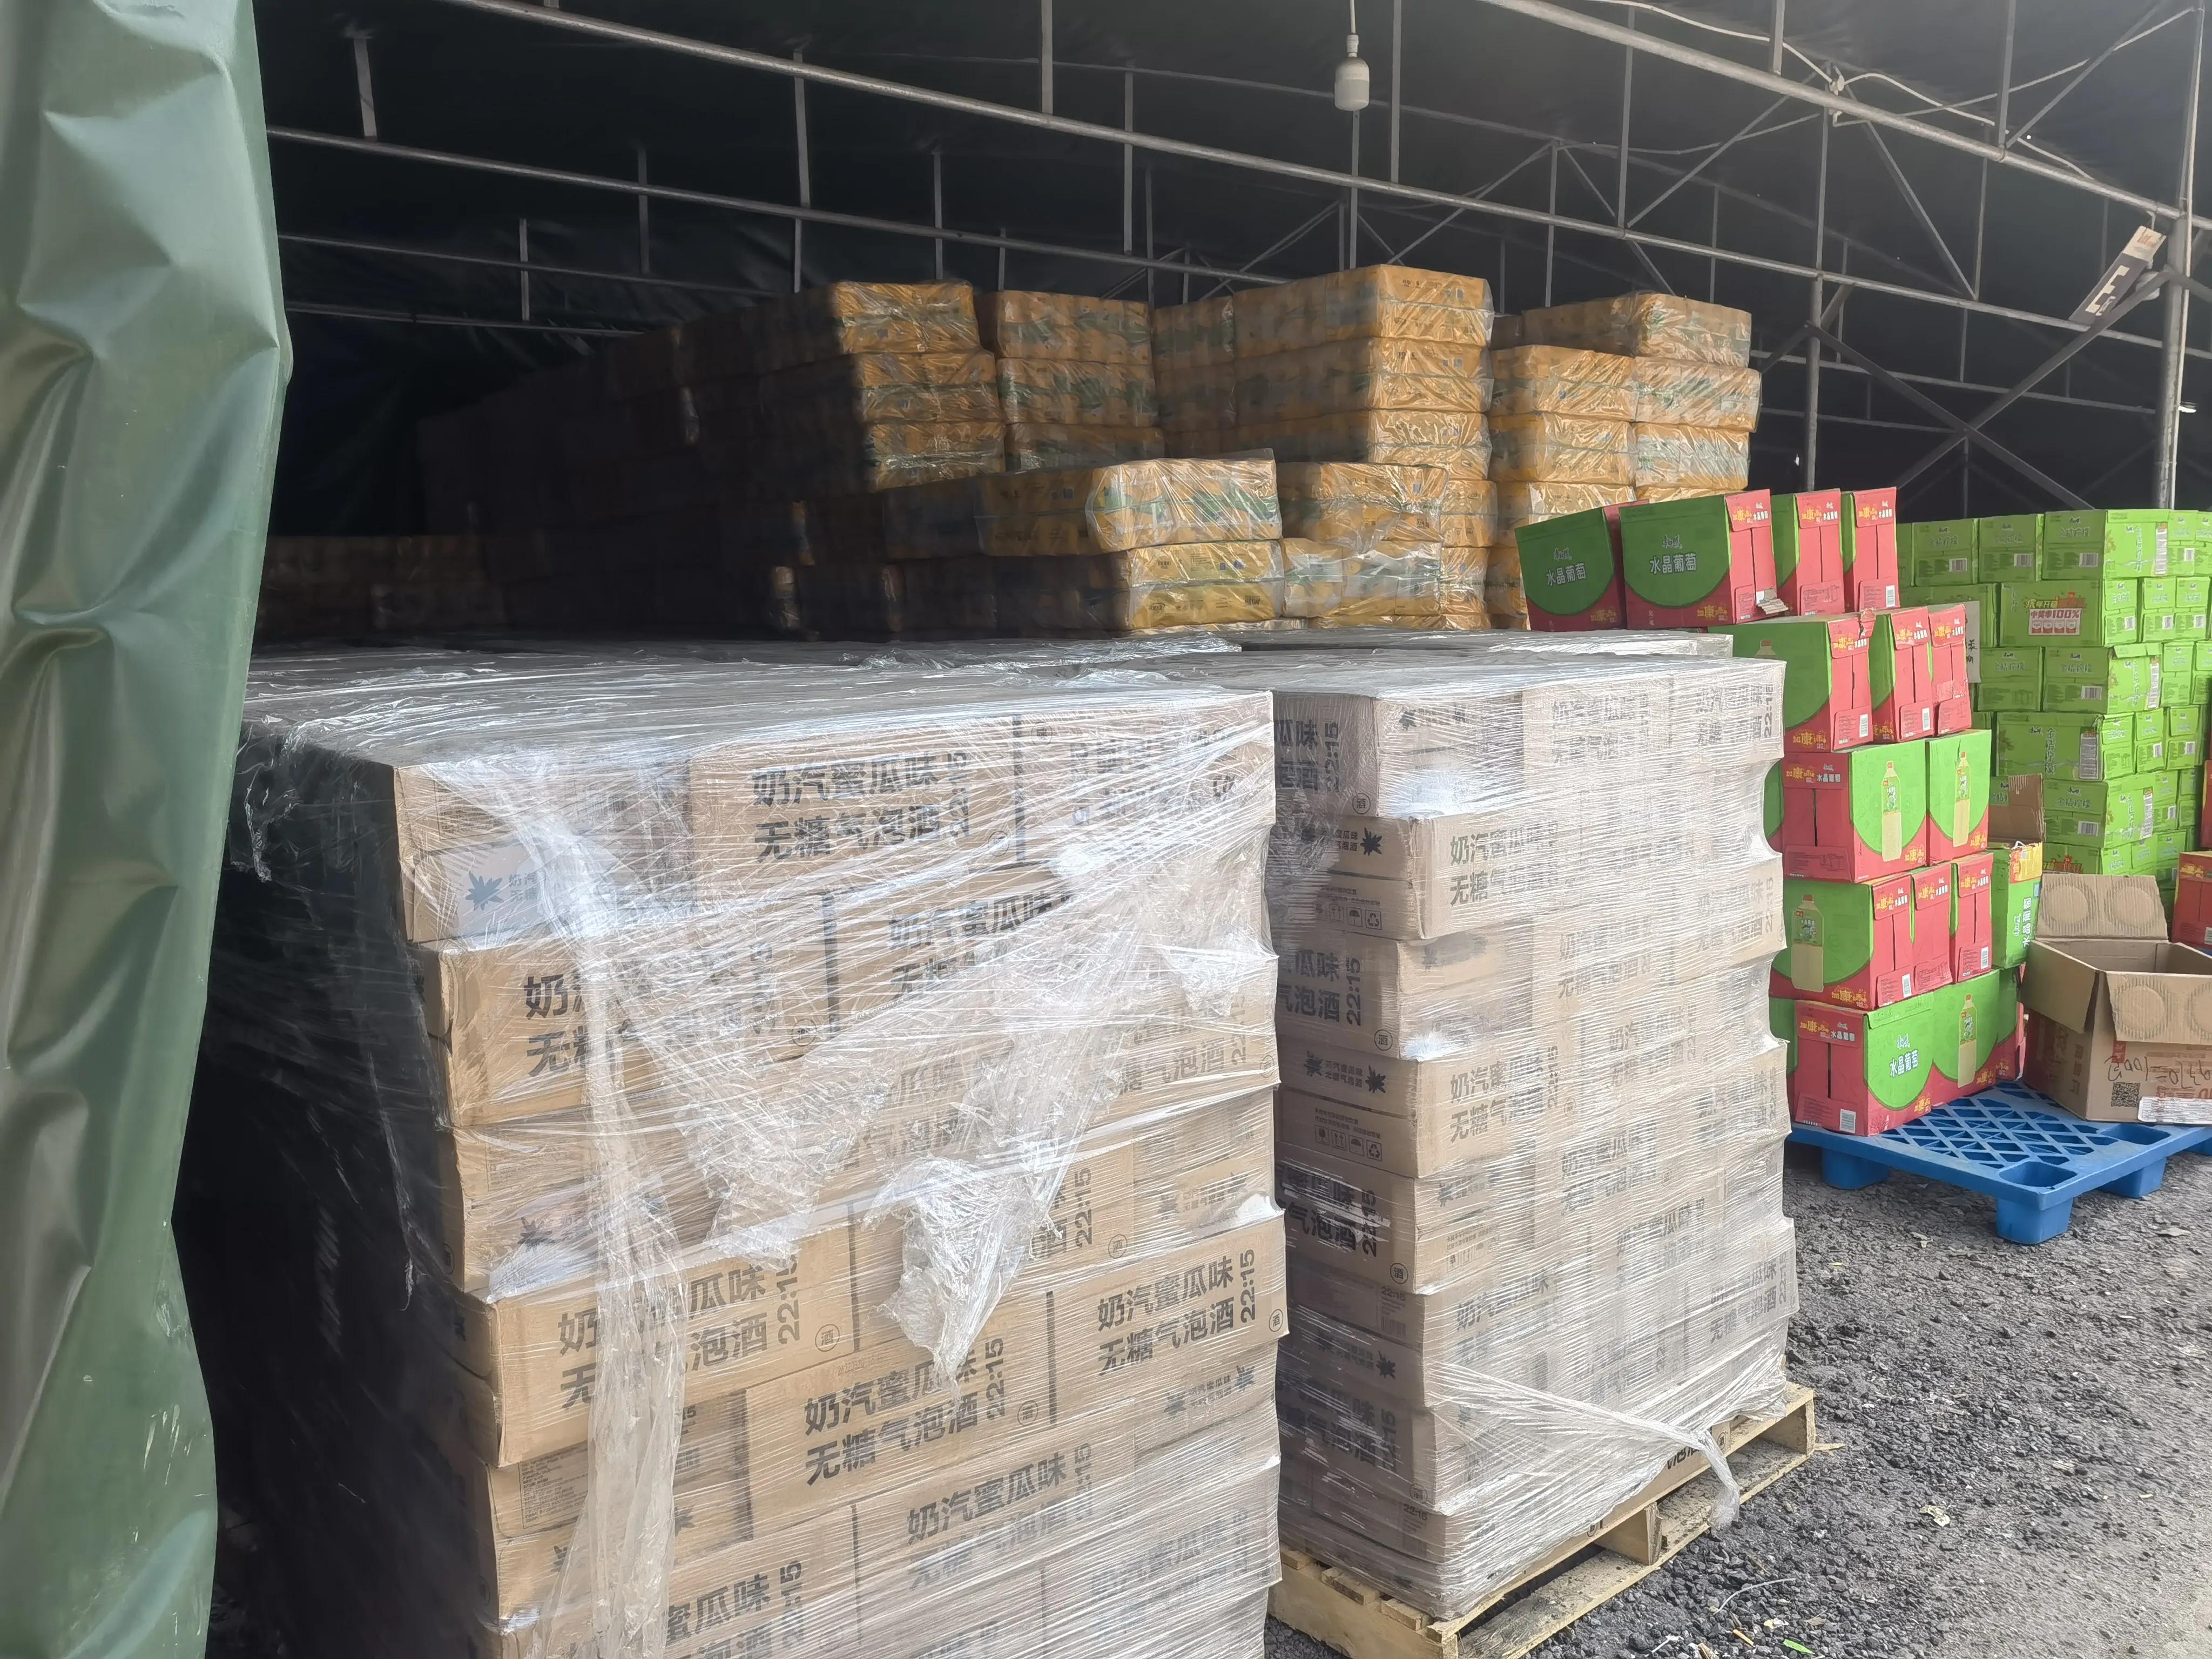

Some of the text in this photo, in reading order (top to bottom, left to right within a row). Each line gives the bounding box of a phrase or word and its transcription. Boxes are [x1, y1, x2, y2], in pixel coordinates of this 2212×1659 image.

[1546, 563, 1586, 586] 水晶葡萄
[1650, 552, 1697, 574] 水晶葡萄
[751, 752, 939, 807] 奶汽蜜瓜味
[754, 803, 941, 864] 无糖气泡酒
[1346, 957, 1361, 1027] 22:15
[1890, 1049, 1919, 1078] 水晶葡萄
[1075, 1168, 1092, 1247] 22:15
[1097, 1256, 1234, 1332] 奶汽蜜瓜味
[1240, 1249, 1256, 1323] 22:15
[1381, 1286, 1406, 1301] 22:15
[1098, 1297, 1235, 1377] 无糖气泡酒
[985, 1338, 1005, 1420] 22:15
[805, 1392, 979, 1486] 无糖气泡酒
[908, 1451, 1067, 1546] 奶汽蜜瓜味
